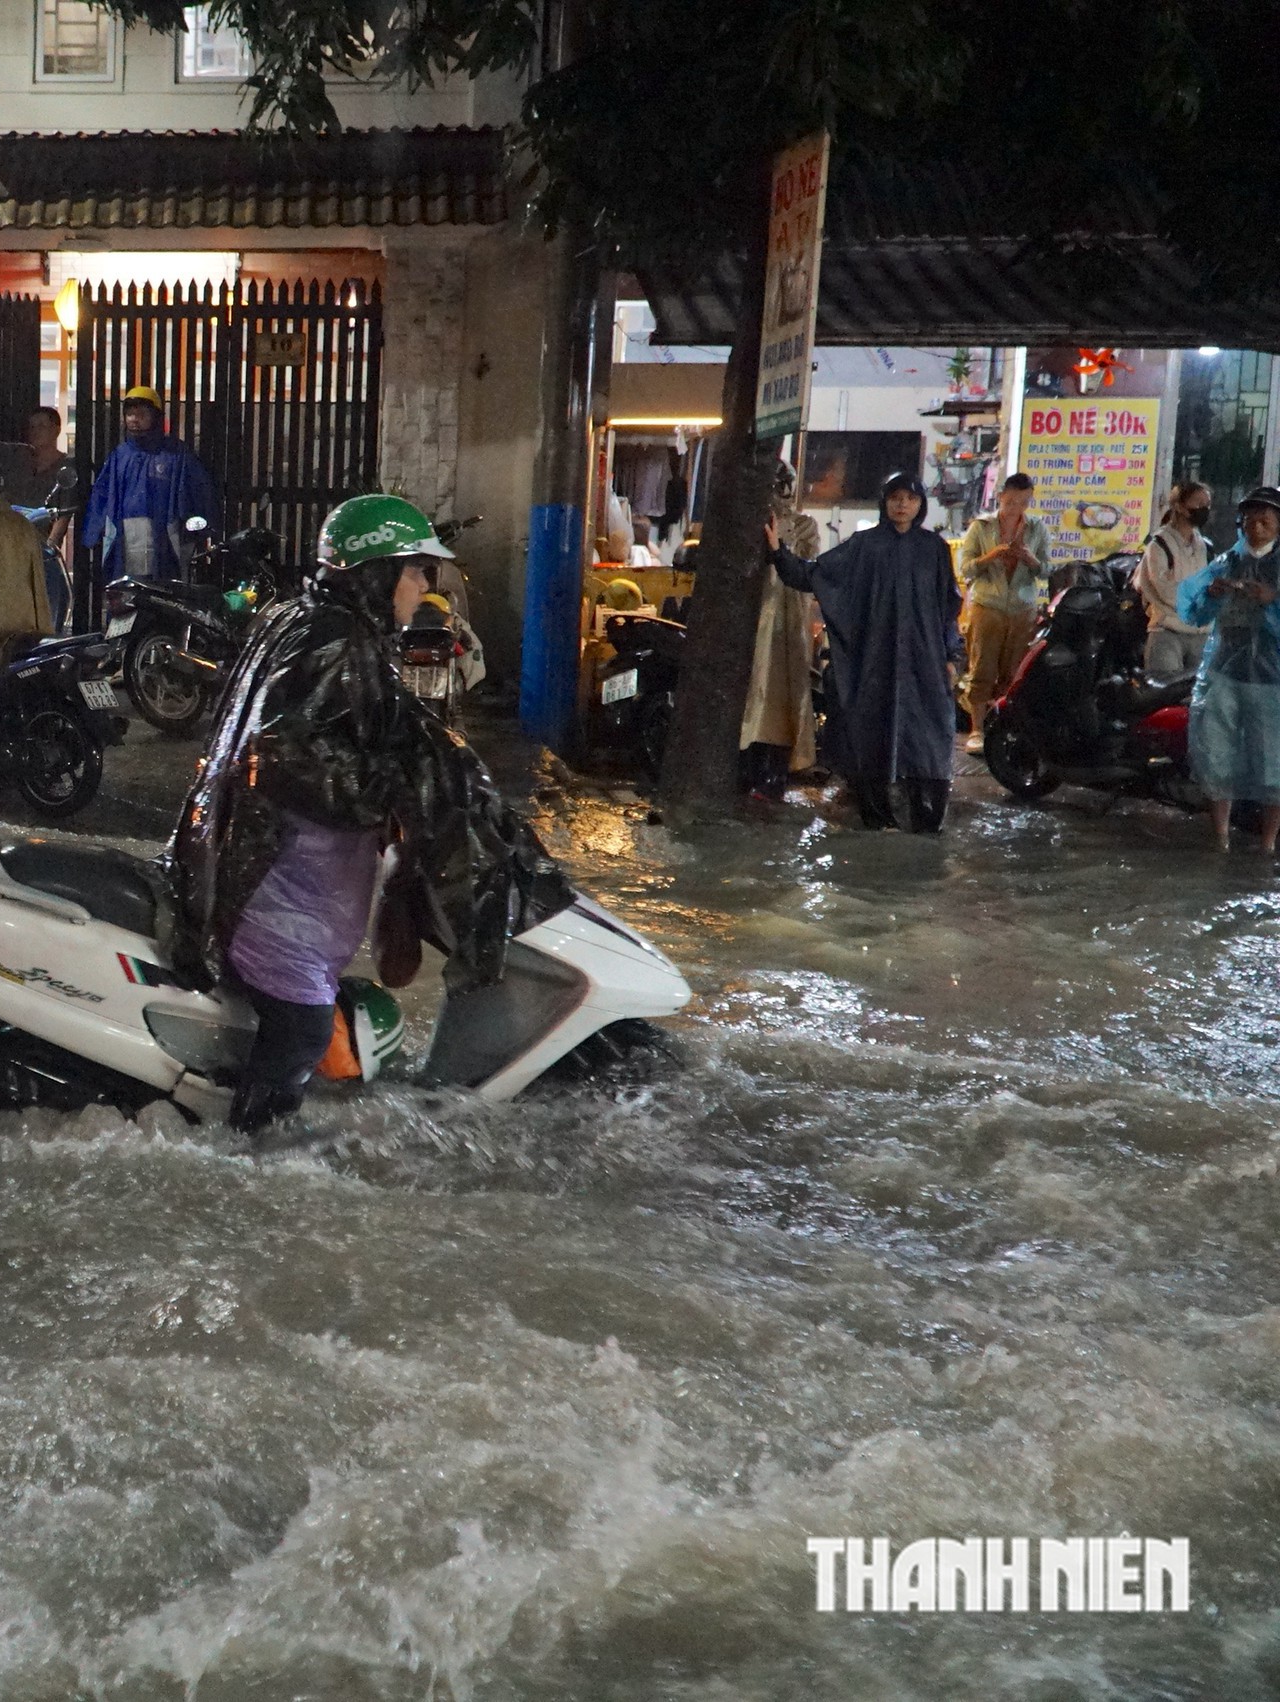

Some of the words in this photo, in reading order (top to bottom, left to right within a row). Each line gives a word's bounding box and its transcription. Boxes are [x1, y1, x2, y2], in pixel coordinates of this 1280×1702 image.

[1030, 407, 1062, 436] BÒ
[1128, 460, 1146, 469] 30K
[1127, 476, 1145, 486] 35K
[344, 523, 396, 552] Grab
